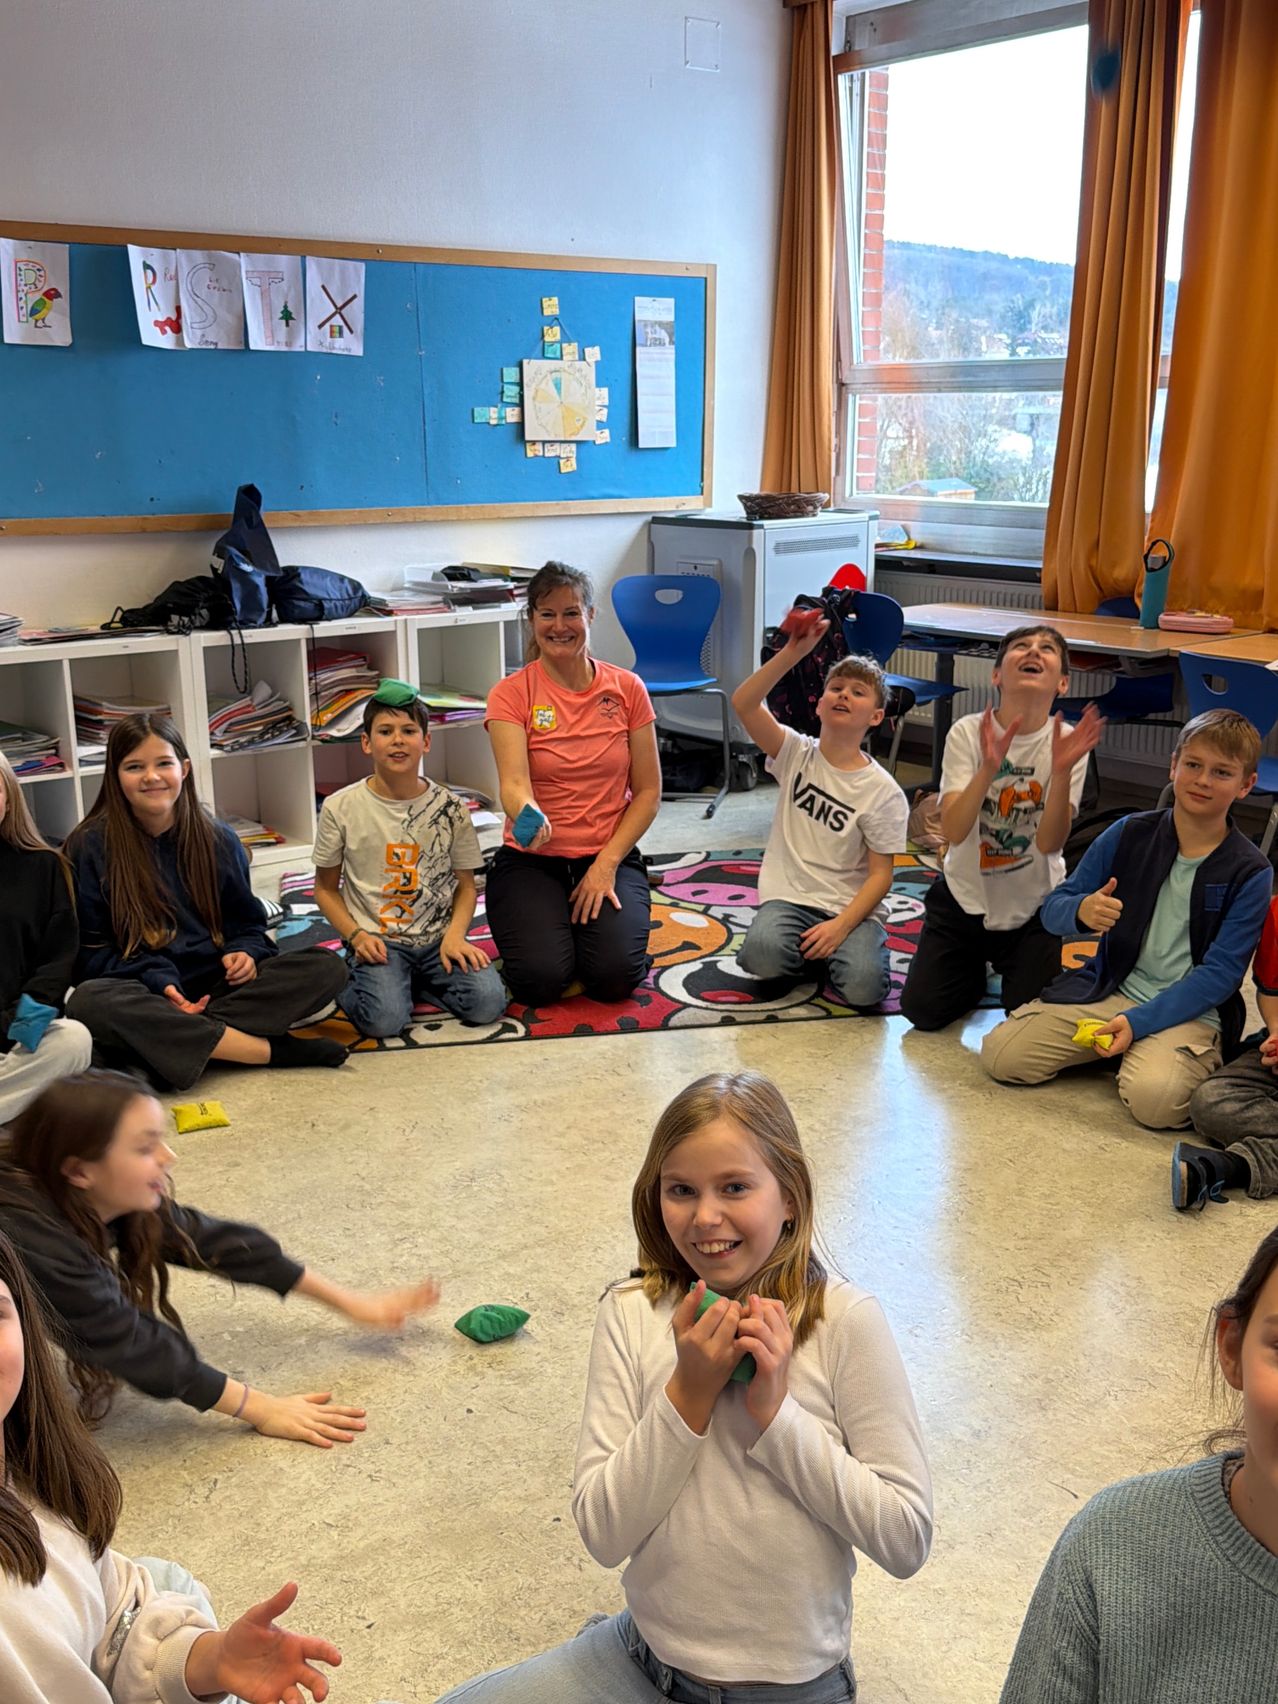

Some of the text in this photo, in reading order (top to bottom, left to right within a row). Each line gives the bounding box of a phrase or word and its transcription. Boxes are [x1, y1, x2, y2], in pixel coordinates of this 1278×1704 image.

[14, 259, 48, 323] P
[142, 260, 161, 312] R
[186, 262, 218, 330] S
[245, 270, 284, 346] T
[317, 284, 358, 335] X
[792, 771, 857, 833] VANS
